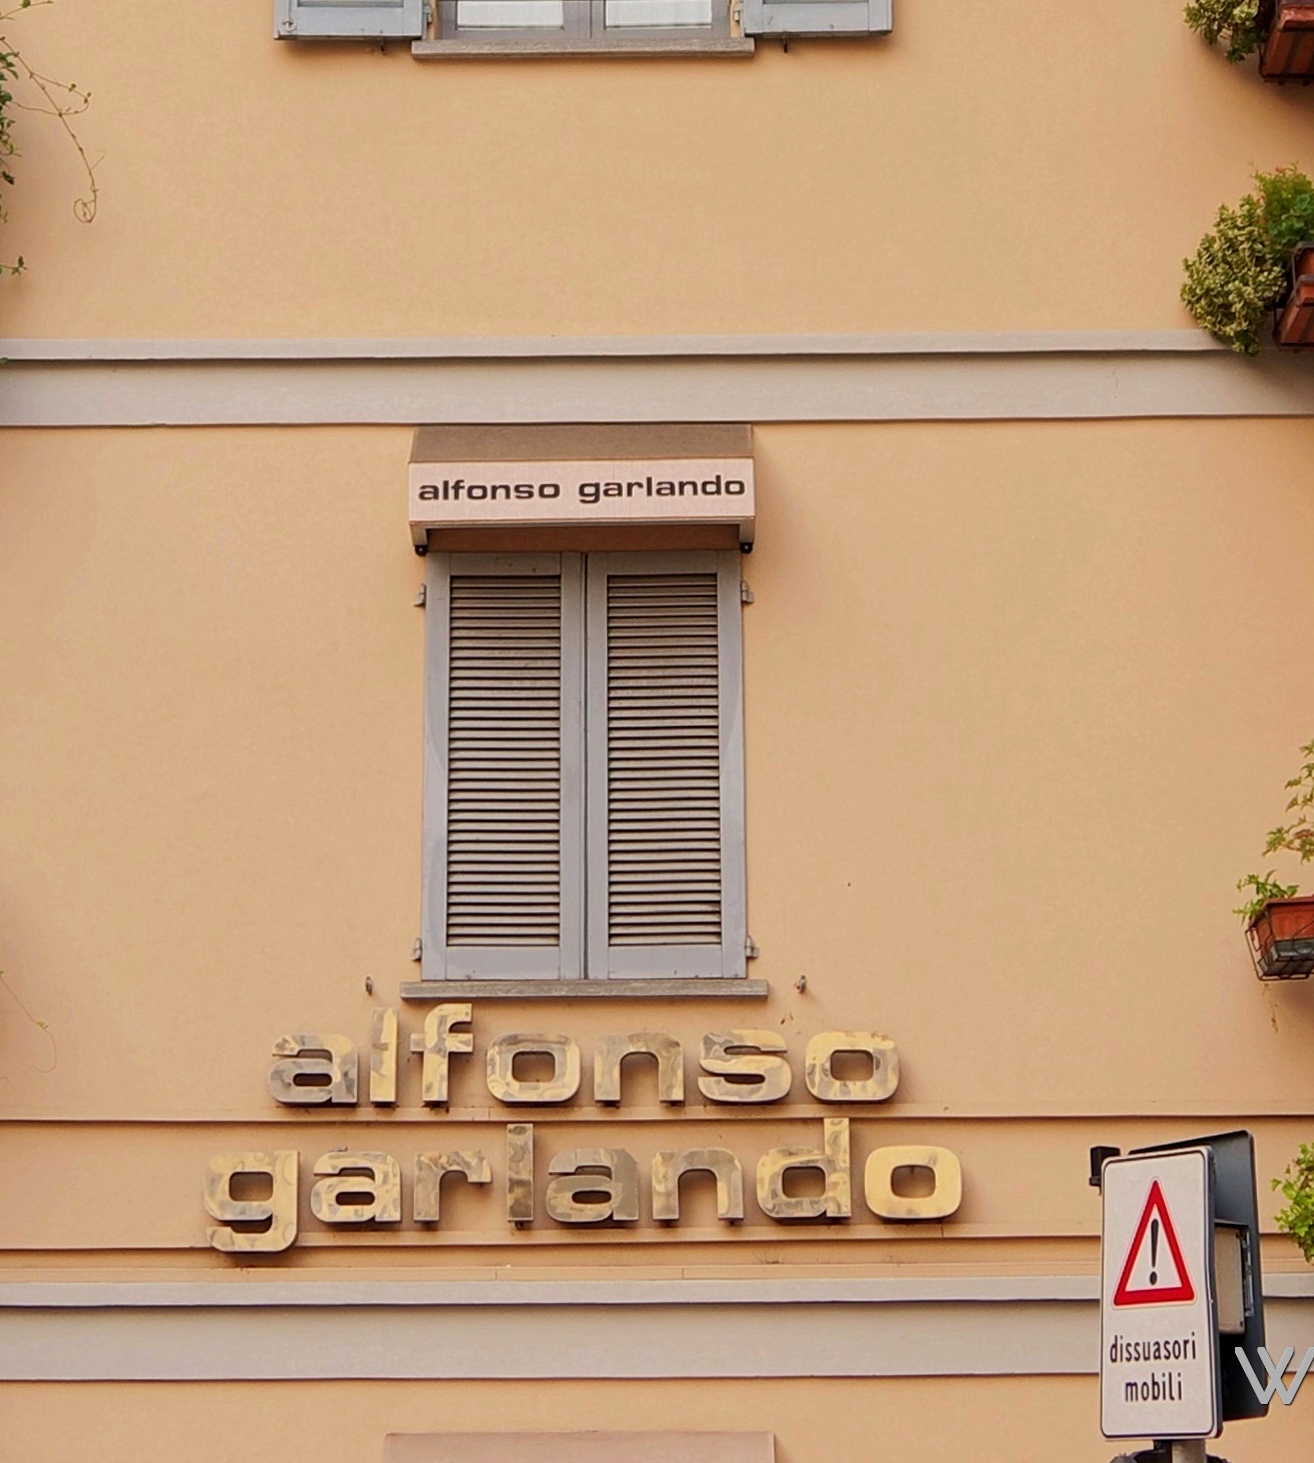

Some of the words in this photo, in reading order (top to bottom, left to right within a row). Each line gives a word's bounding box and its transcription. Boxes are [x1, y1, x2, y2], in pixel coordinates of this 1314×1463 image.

[418, 479, 561, 501] alfonso
[578, 474, 746, 504] garlando
[268, 1003, 900, 1105] alfonso
[202, 1117, 964, 1253] garlando
[1109, 1331, 1196, 1363] dissuasori
[1125, 1371, 1182, 1402] mobili
